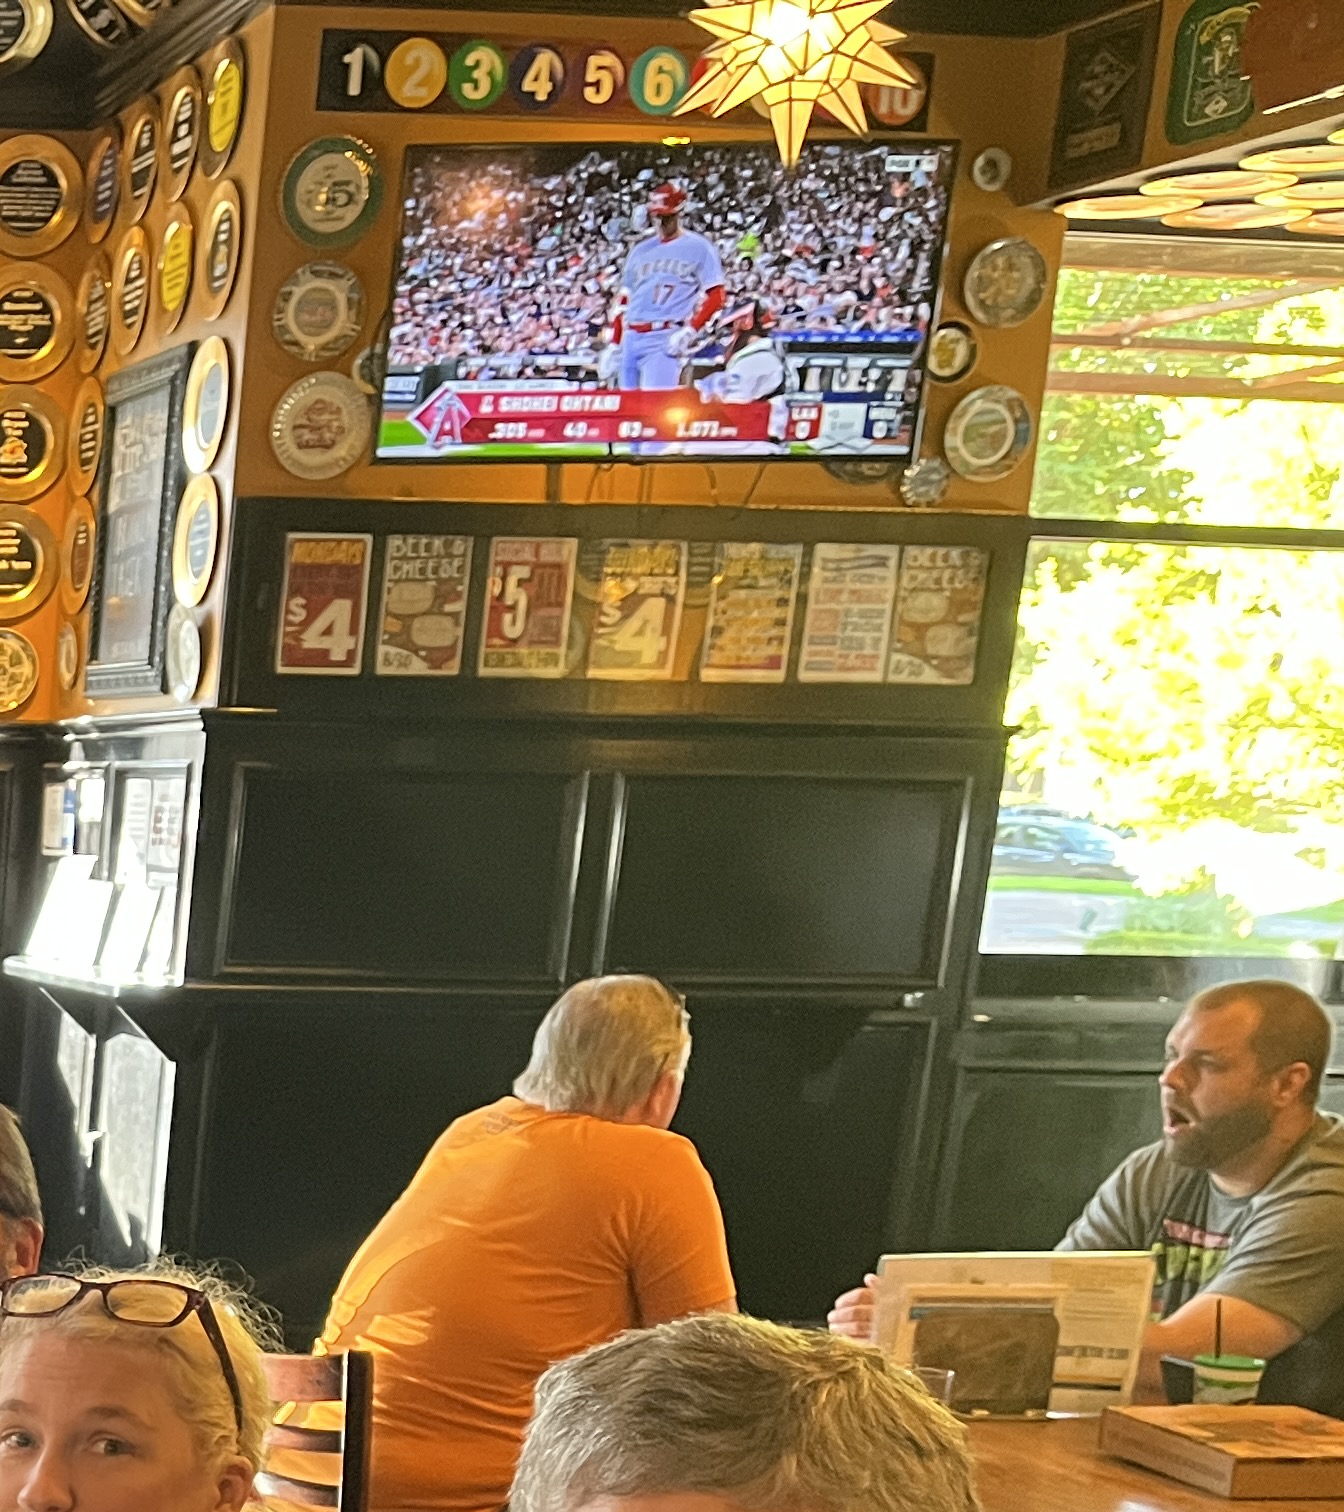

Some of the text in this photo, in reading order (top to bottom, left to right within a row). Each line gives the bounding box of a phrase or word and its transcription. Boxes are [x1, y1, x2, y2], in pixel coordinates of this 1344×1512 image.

[343, 42, 364, 96] 1
[402, 46, 432, 100] 2
[461, 49, 492, 101] 3
[521, 51, 554, 102] 4
[582, 54, 616, 105] 5
[643, 55, 676, 107] 6
[285, 597, 356, 661] $4
